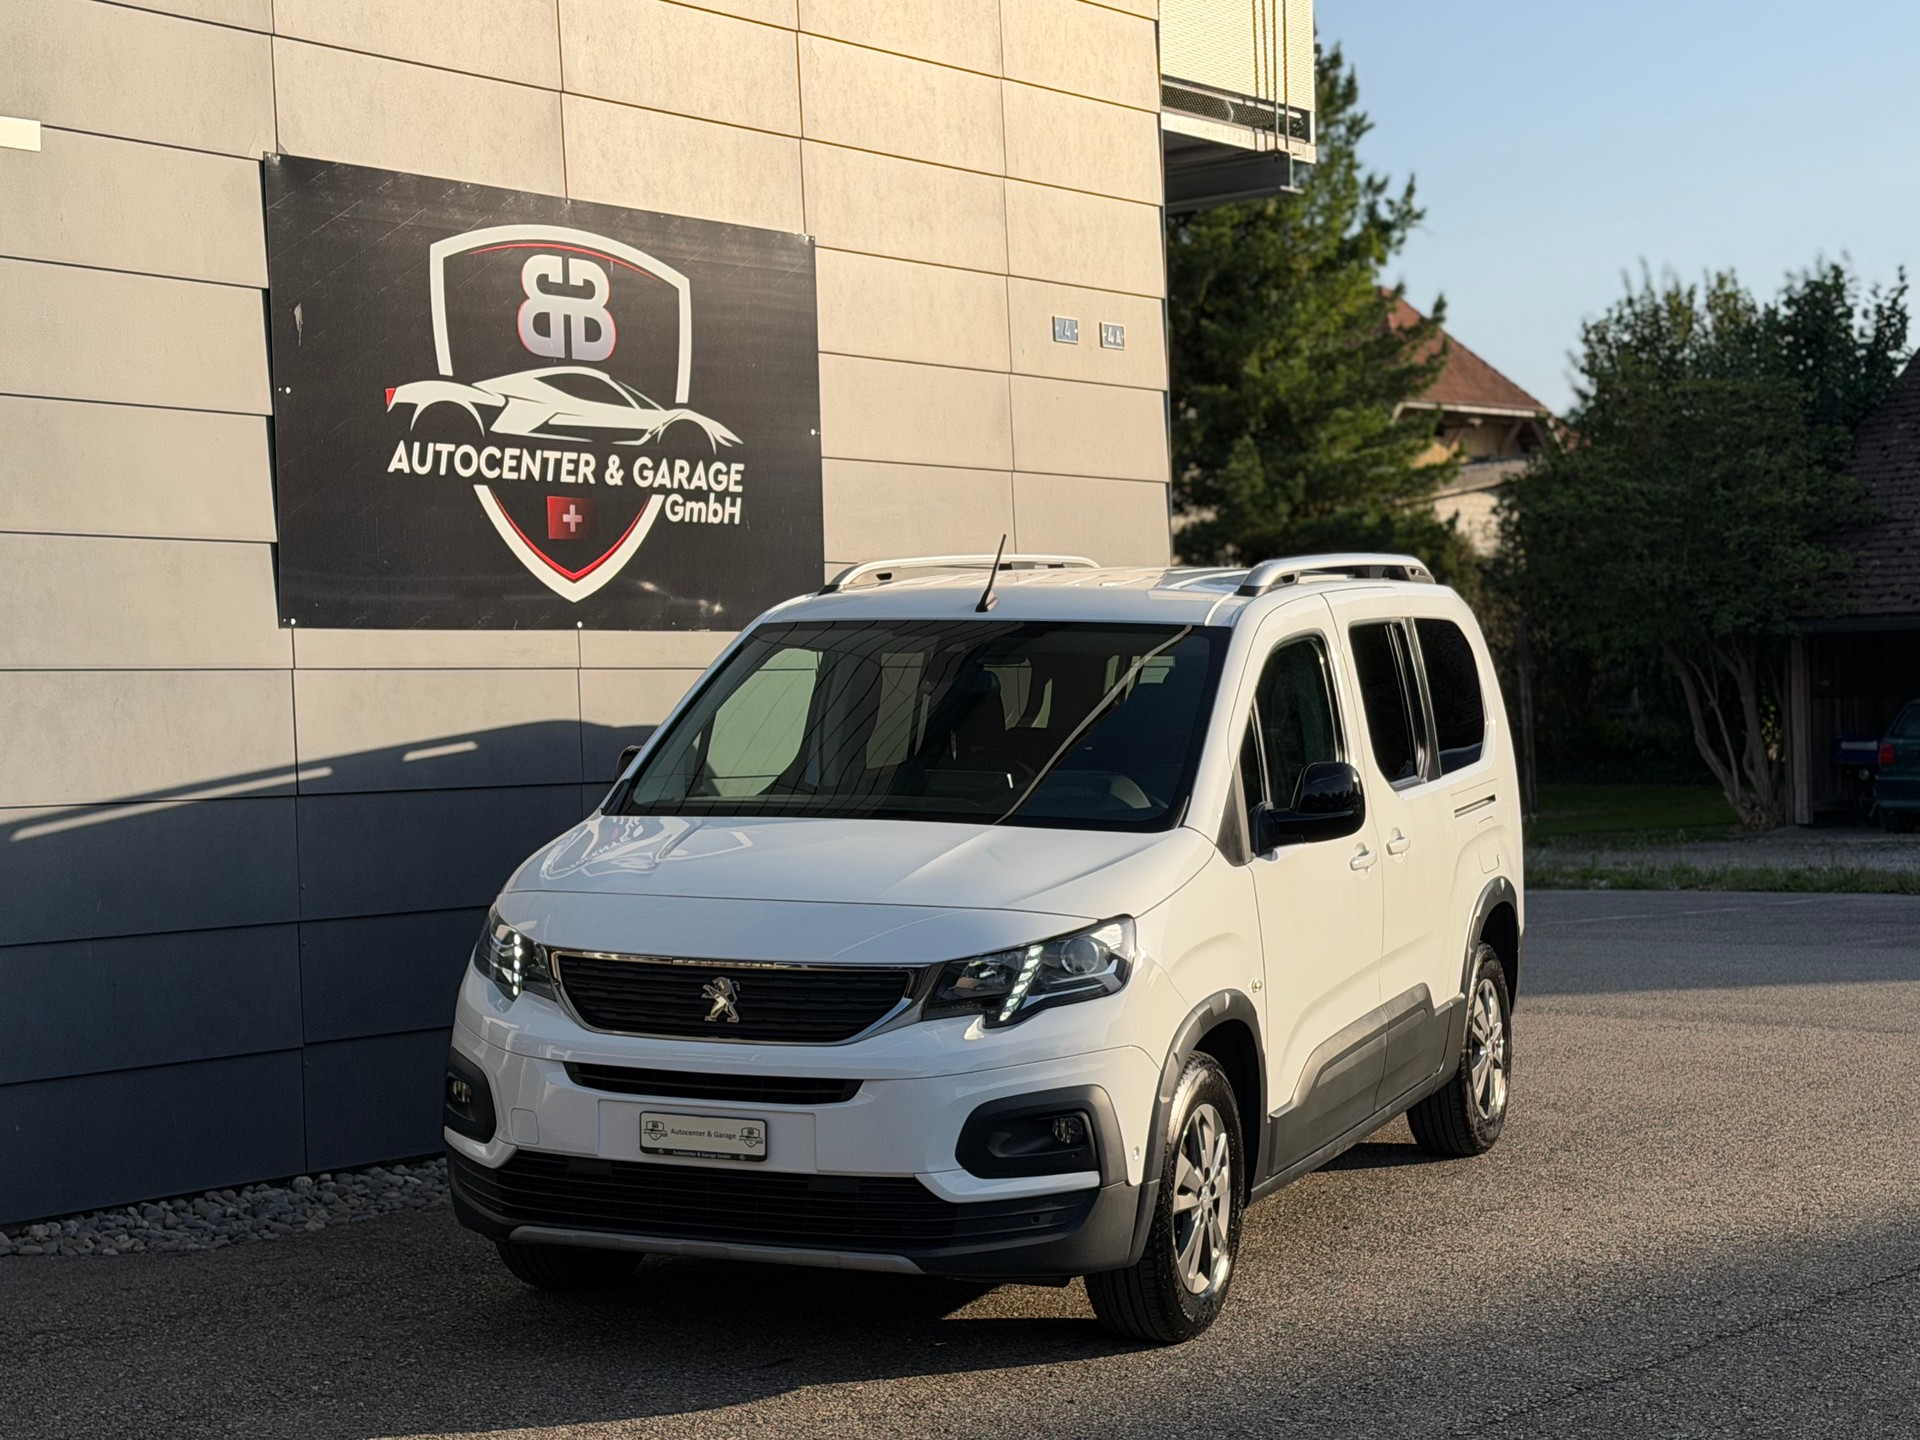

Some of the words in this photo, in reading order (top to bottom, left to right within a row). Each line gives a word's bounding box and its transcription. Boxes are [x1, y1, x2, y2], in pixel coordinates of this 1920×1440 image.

[1063, 320, 1071, 338] 4
[387, 440, 596, 484] AUTOCENTER
[604, 454, 625, 487] &
[633, 456, 745, 492] GARAGE
[665, 493, 742, 525] GmbH
[671, 1128, 706, 1137] Autocenter
[707, 1130, 713, 1138] &
[713, 1131, 737, 1141] Garage
